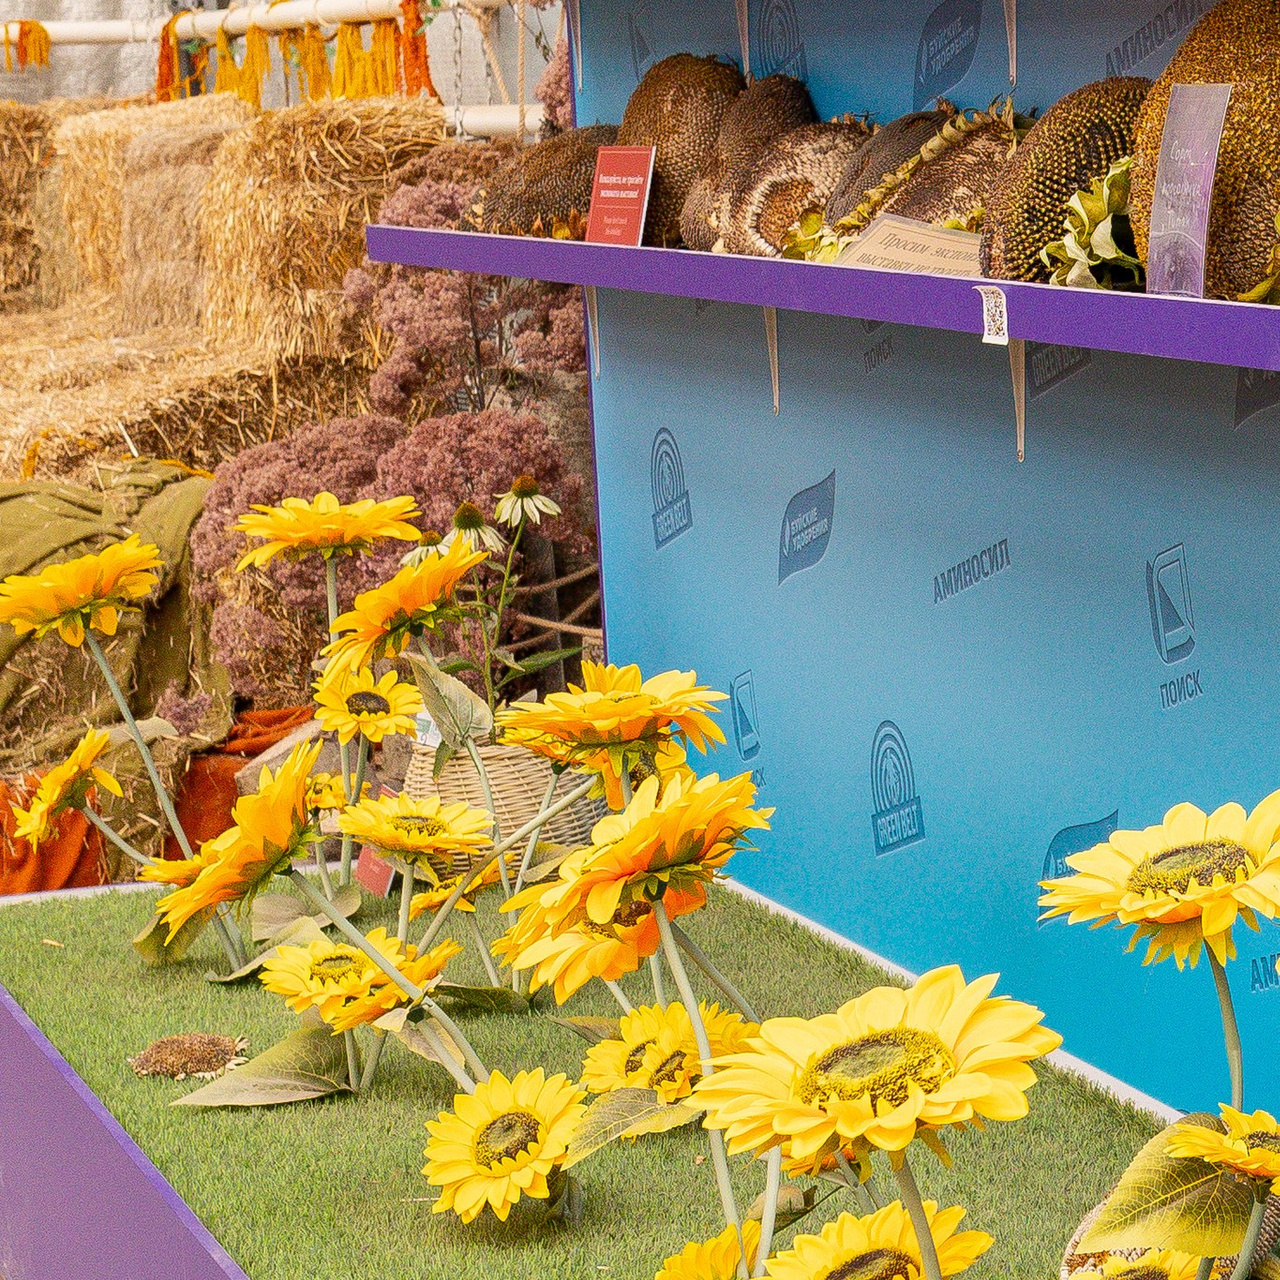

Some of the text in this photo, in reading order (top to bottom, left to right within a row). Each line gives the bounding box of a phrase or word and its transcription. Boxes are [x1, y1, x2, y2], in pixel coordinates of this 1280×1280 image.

[879, 233, 932, 254] Просим
[857, 253, 915, 272] выставки
[933, 538, 1012, 604] АМИНОСИЛ
[1159, 670, 1204, 709] ПОИСК
